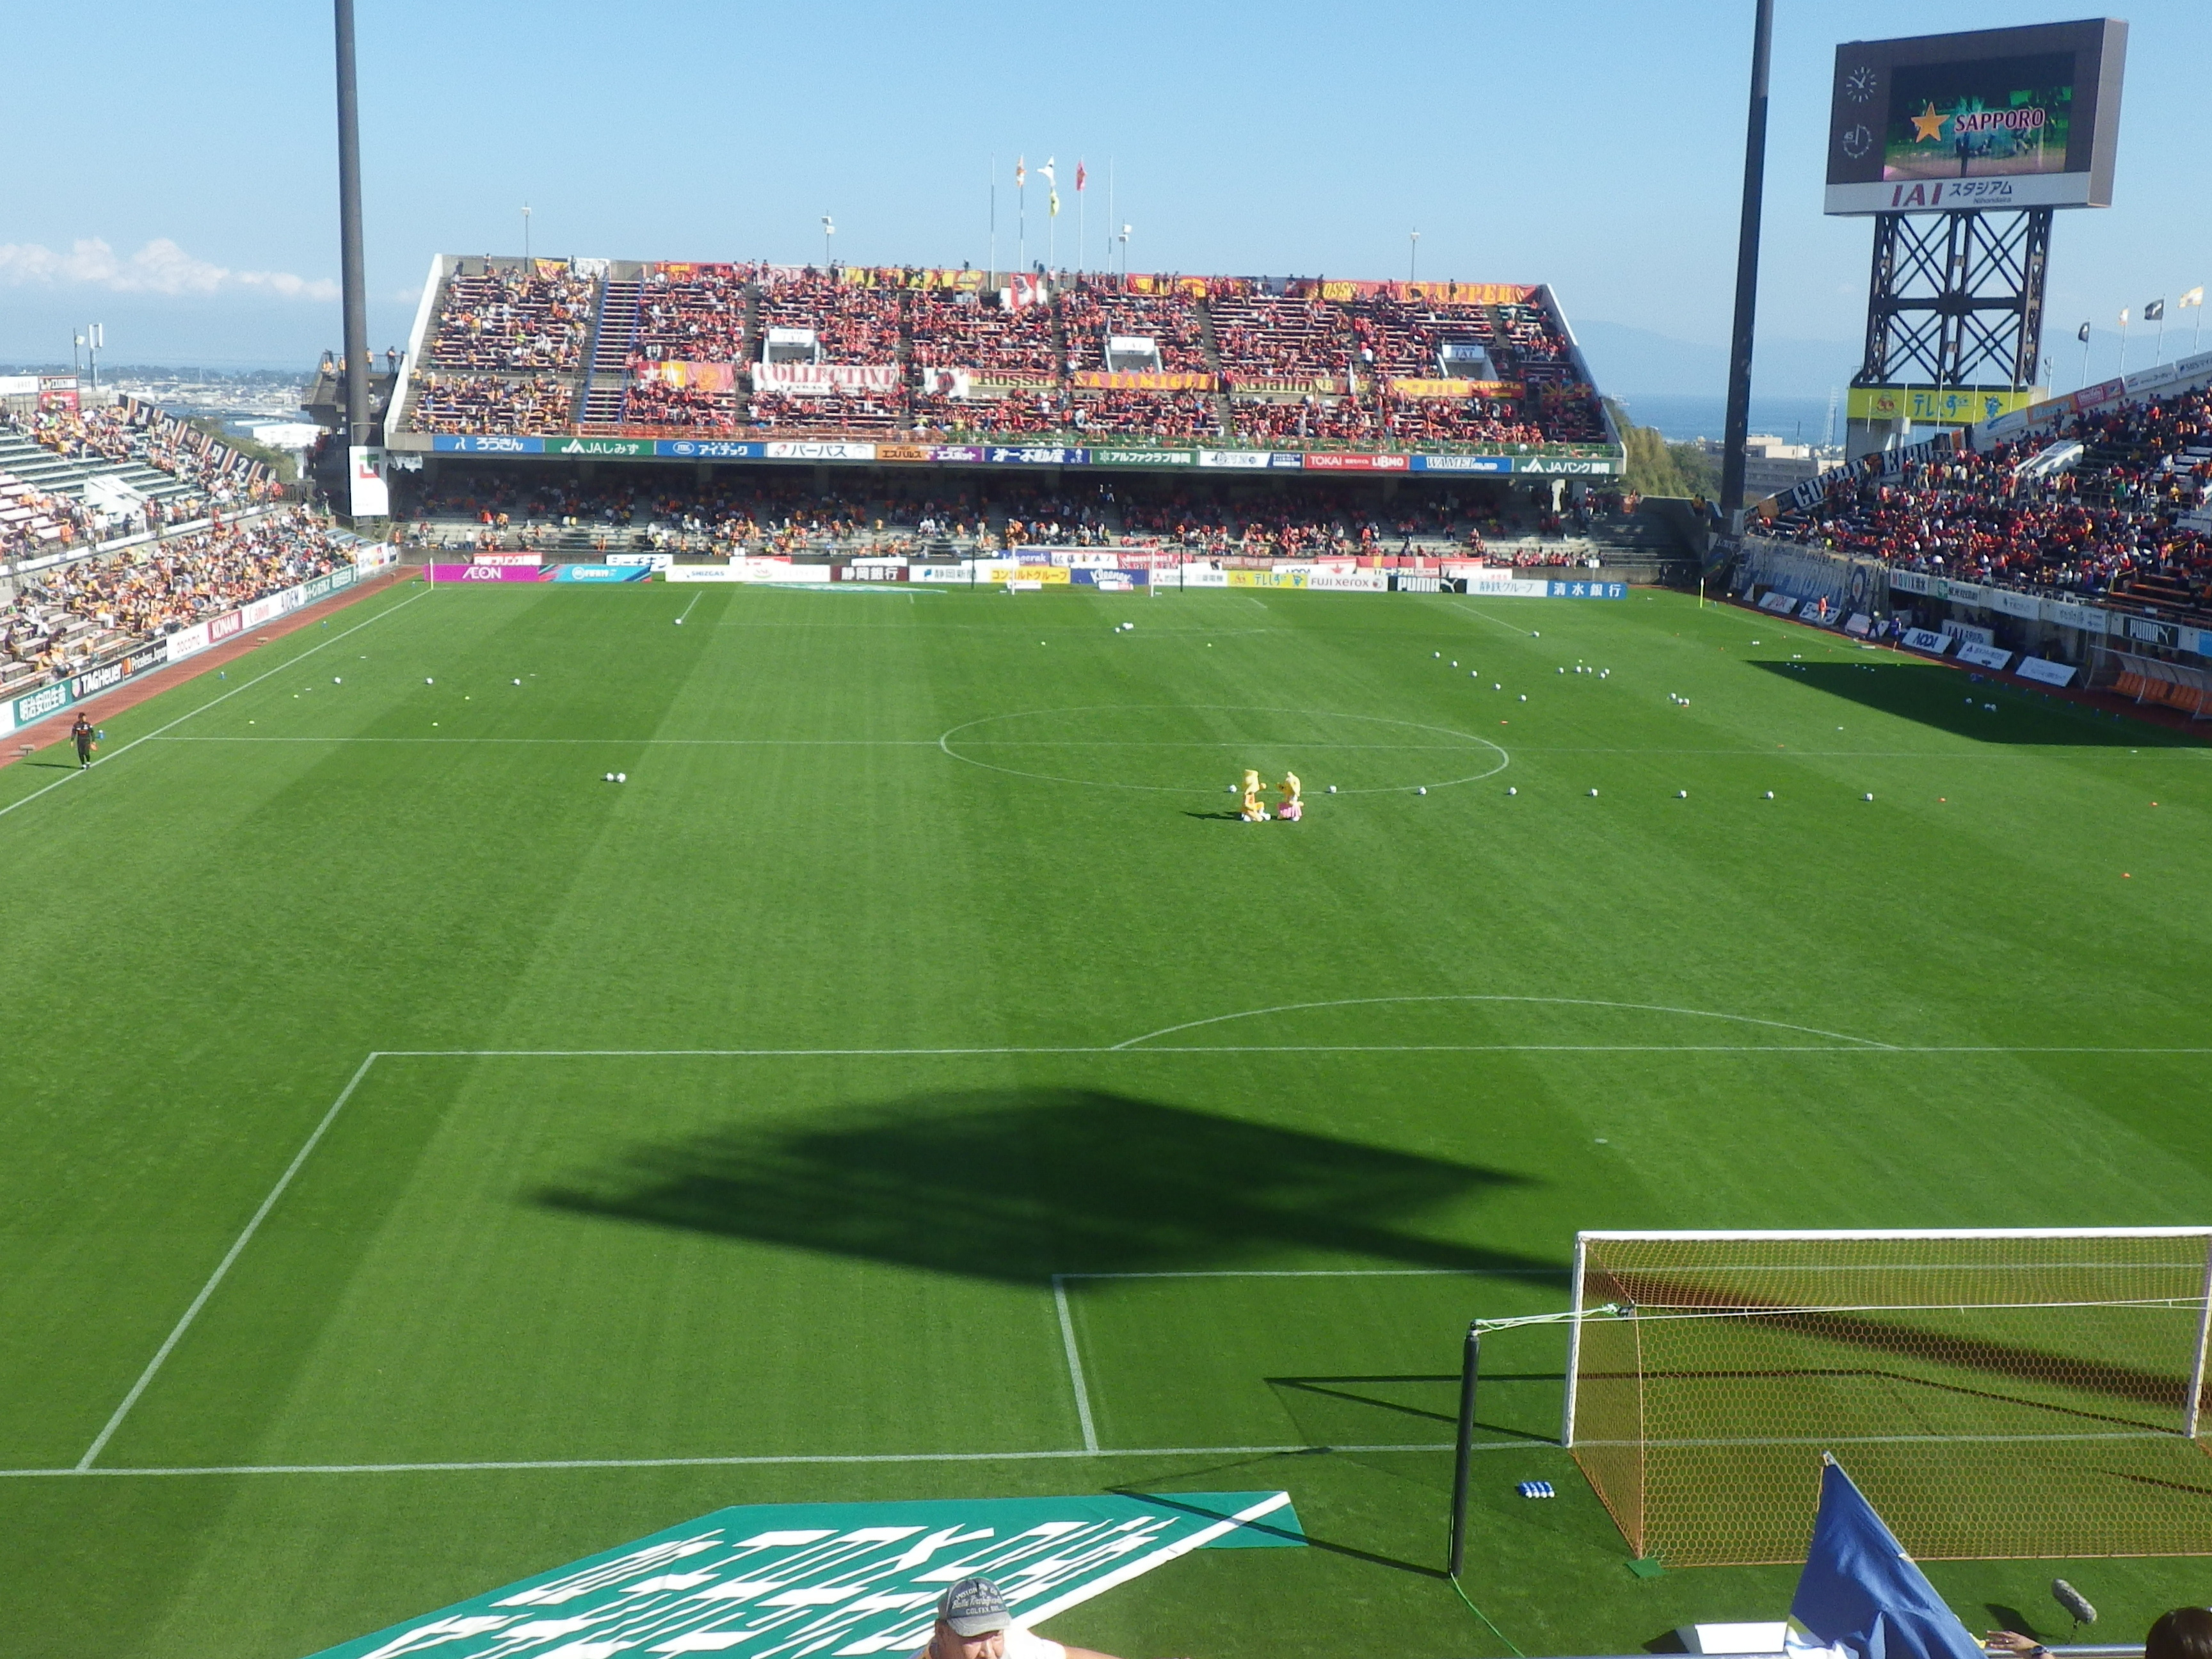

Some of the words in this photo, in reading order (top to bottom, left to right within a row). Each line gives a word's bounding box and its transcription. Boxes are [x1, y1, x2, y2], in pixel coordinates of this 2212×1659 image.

[1954, 109, 2044, 132] SAPPORO
[1891, 182, 1944, 207] IAI
[1950, 181, 2012, 197] スタジアム
[476, 437, 524, 451] ろうきん
[586, 442, 639, 455] JAしみず
[1110, 451, 1191, 463] アルファクラブ静岡
[1310, 456, 1342, 466] TOKAI
[1372, 455, 1404, 468] LIBMO
[1546, 461, 1610, 474] JAバンク静岡
[841, 566, 897, 581] 静岡銀行
[1311, 577, 1333, 586] FUJI
[1397, 576, 1440, 593] PUMA
[1479, 581, 1535, 593] 静鉄グループ
[1553, 582, 1621, 598] 清水銀行
[211, 613, 239, 639] KONAMI
[131, 651, 152, 672] Priceless
[19, 683, 67, 721] 明治安田生命
